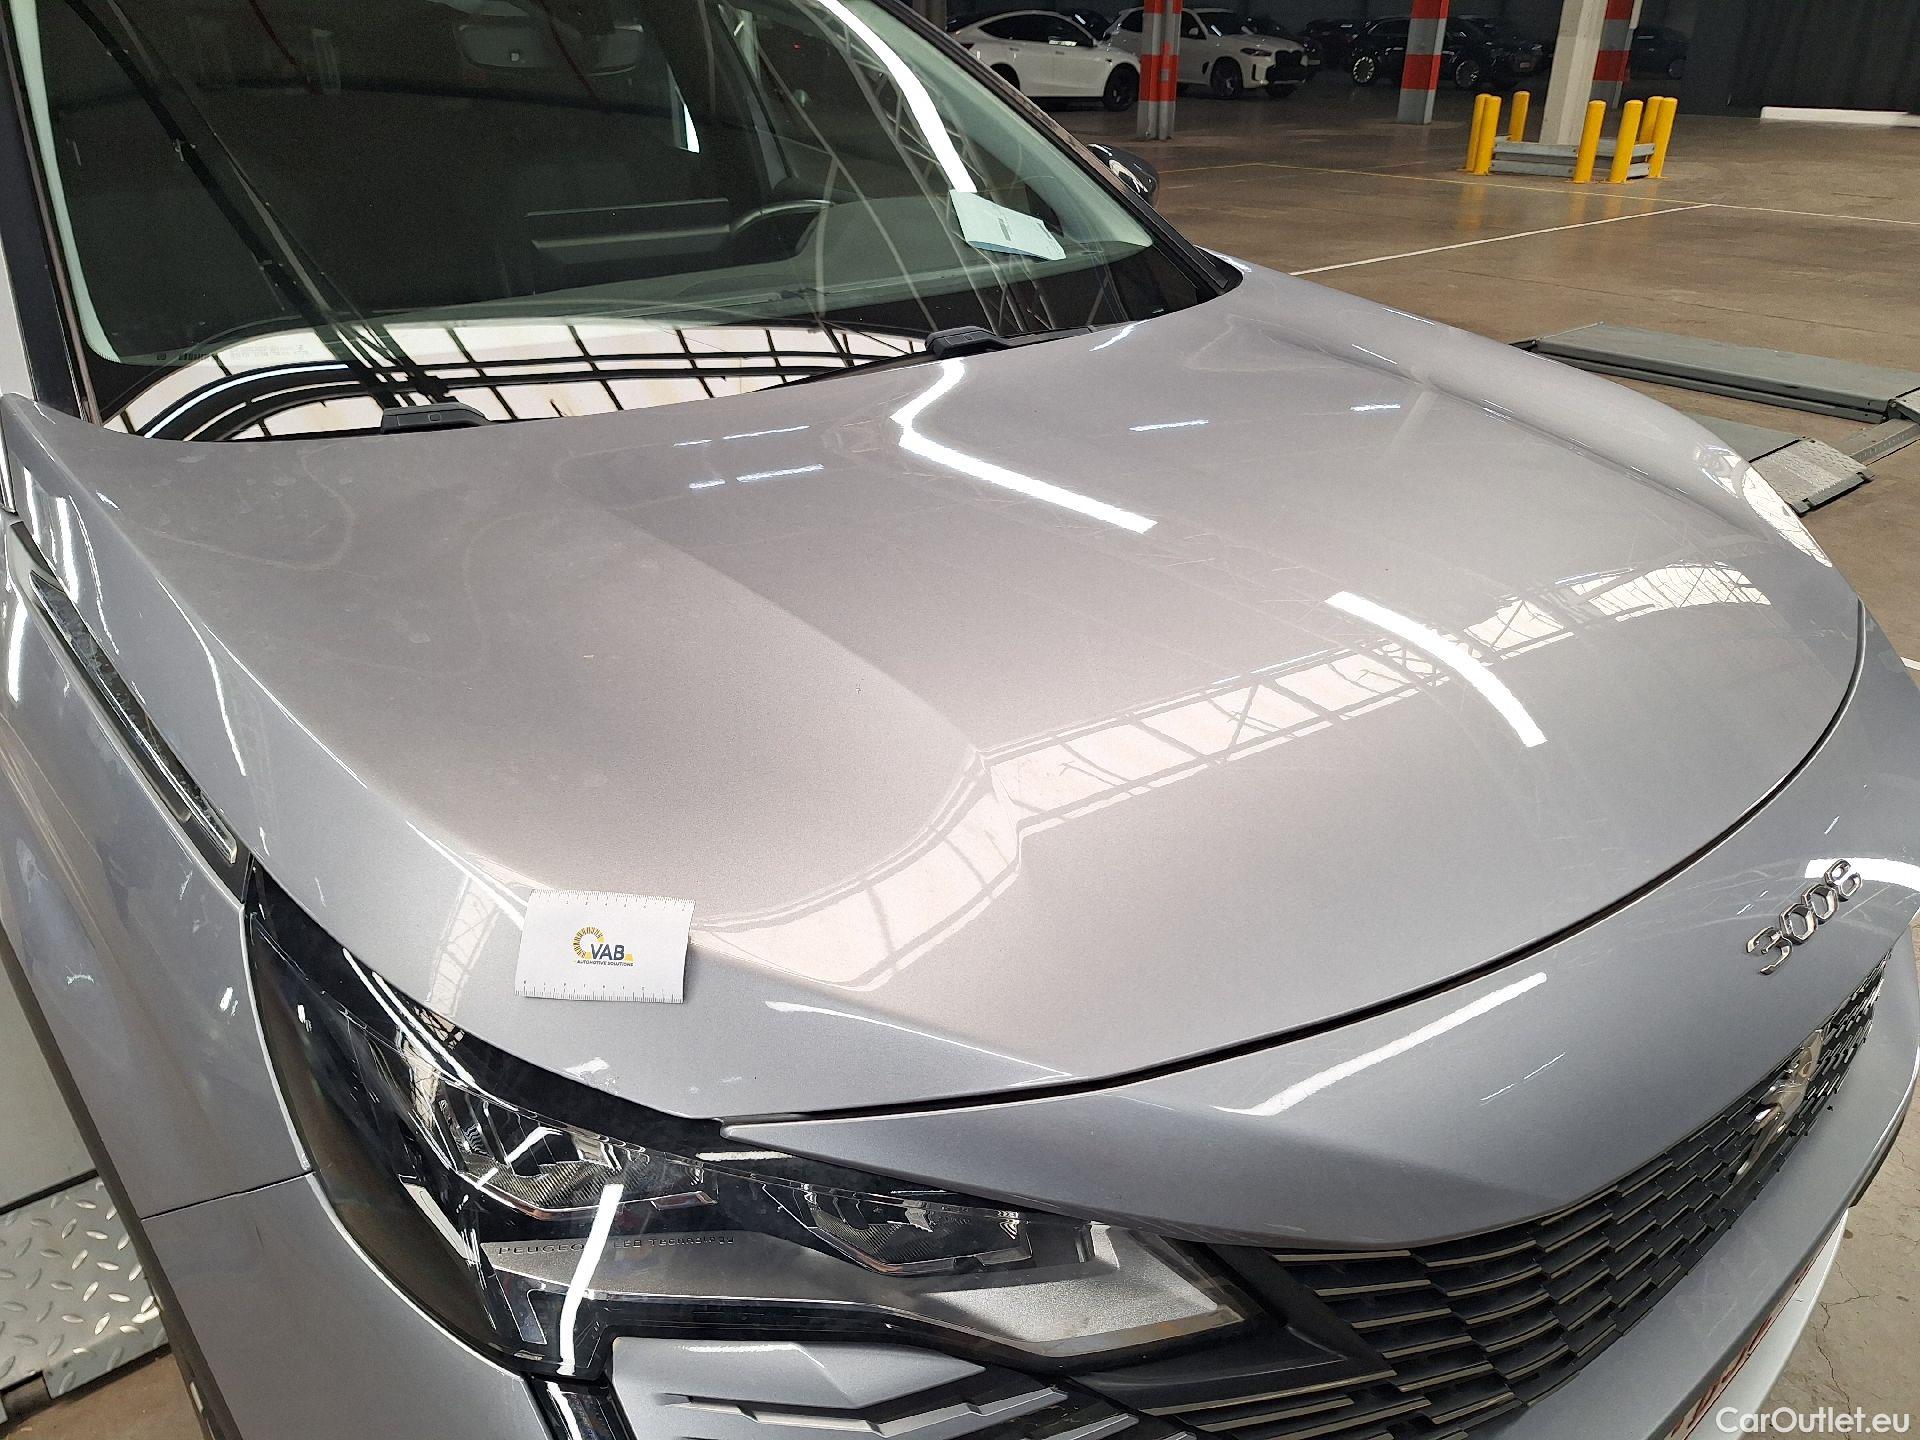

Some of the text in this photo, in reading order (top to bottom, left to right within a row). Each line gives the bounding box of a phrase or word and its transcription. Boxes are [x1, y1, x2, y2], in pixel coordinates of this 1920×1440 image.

[1746, 859, 1863, 975] 3008
[590, 943, 625, 960] VAB
[498, 1243, 584, 1255] PEUGEO
